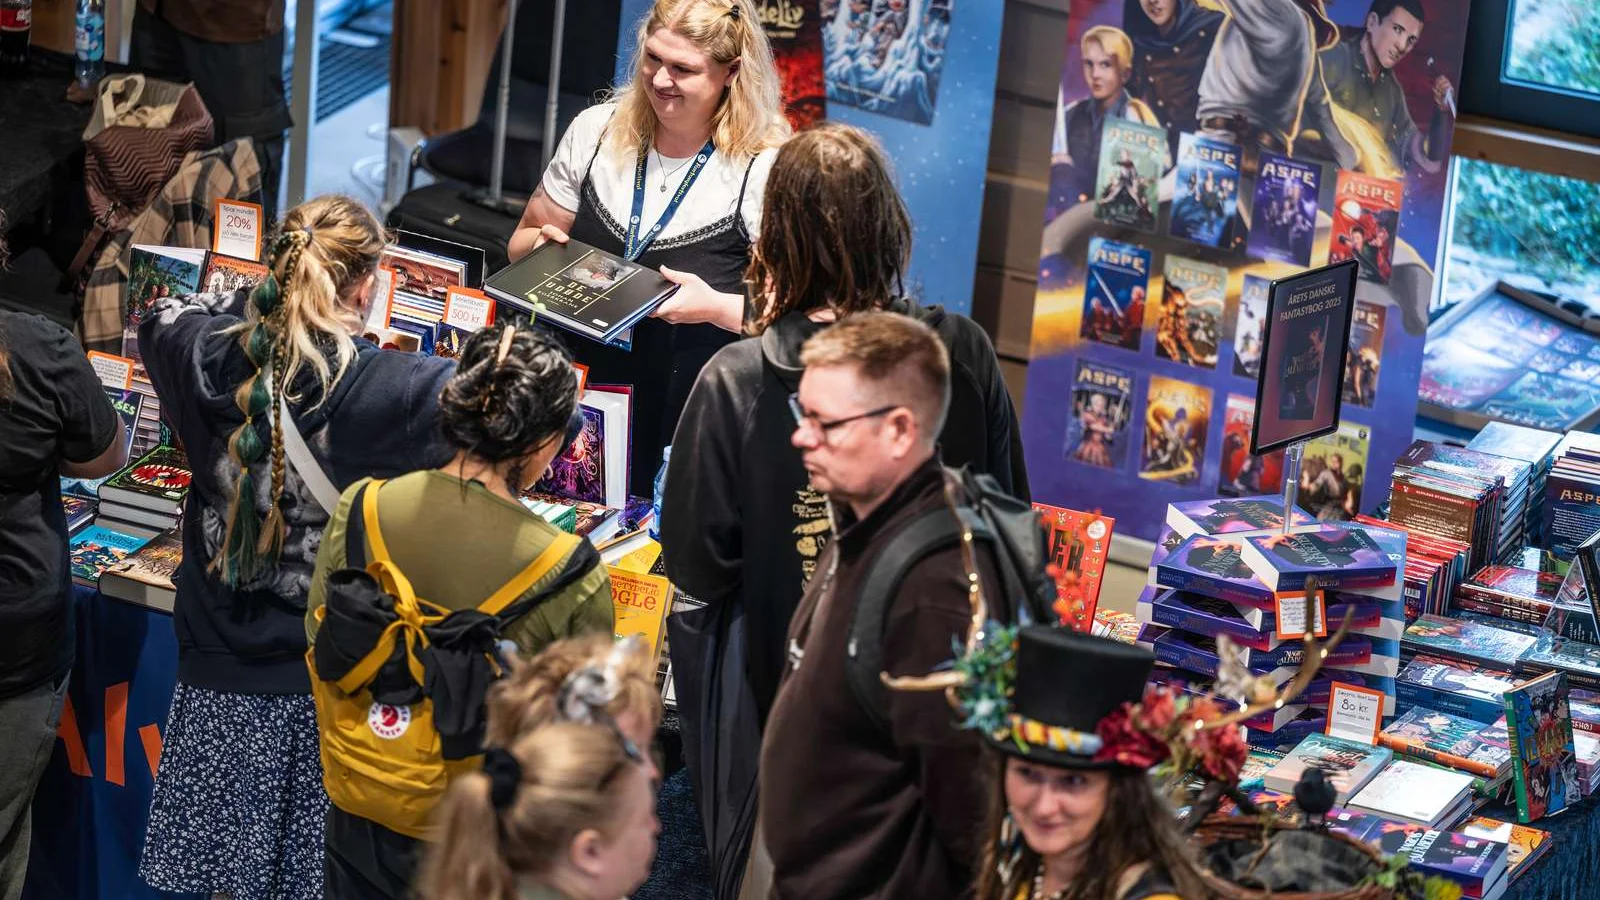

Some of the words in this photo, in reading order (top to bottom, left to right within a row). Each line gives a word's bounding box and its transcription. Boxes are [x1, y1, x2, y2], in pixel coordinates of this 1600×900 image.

[1183, 143, 1236, 169] ASPE
[1261, 162, 1316, 188] ASPE
[1343, 181, 1396, 206] ASPE
[226, 215, 252, 230] 20%
[1093, 249, 1146, 275] ASPE
[567, 280, 588, 292] DE
[1287, 291, 1308, 306] ÅRETS
[1308, 284, 1337, 299] DANSKE
[451, 309, 470, 321] 500
[1280, 302, 1324, 322] FANTASYBOG
[1324, 296, 1342, 309] 2025
[1353, 308, 1379, 329] PE
[1078, 367, 1130, 394] ASPE
[1502, 608, 1541, 623] ASPE
[1341, 698, 1356, 710] 80
